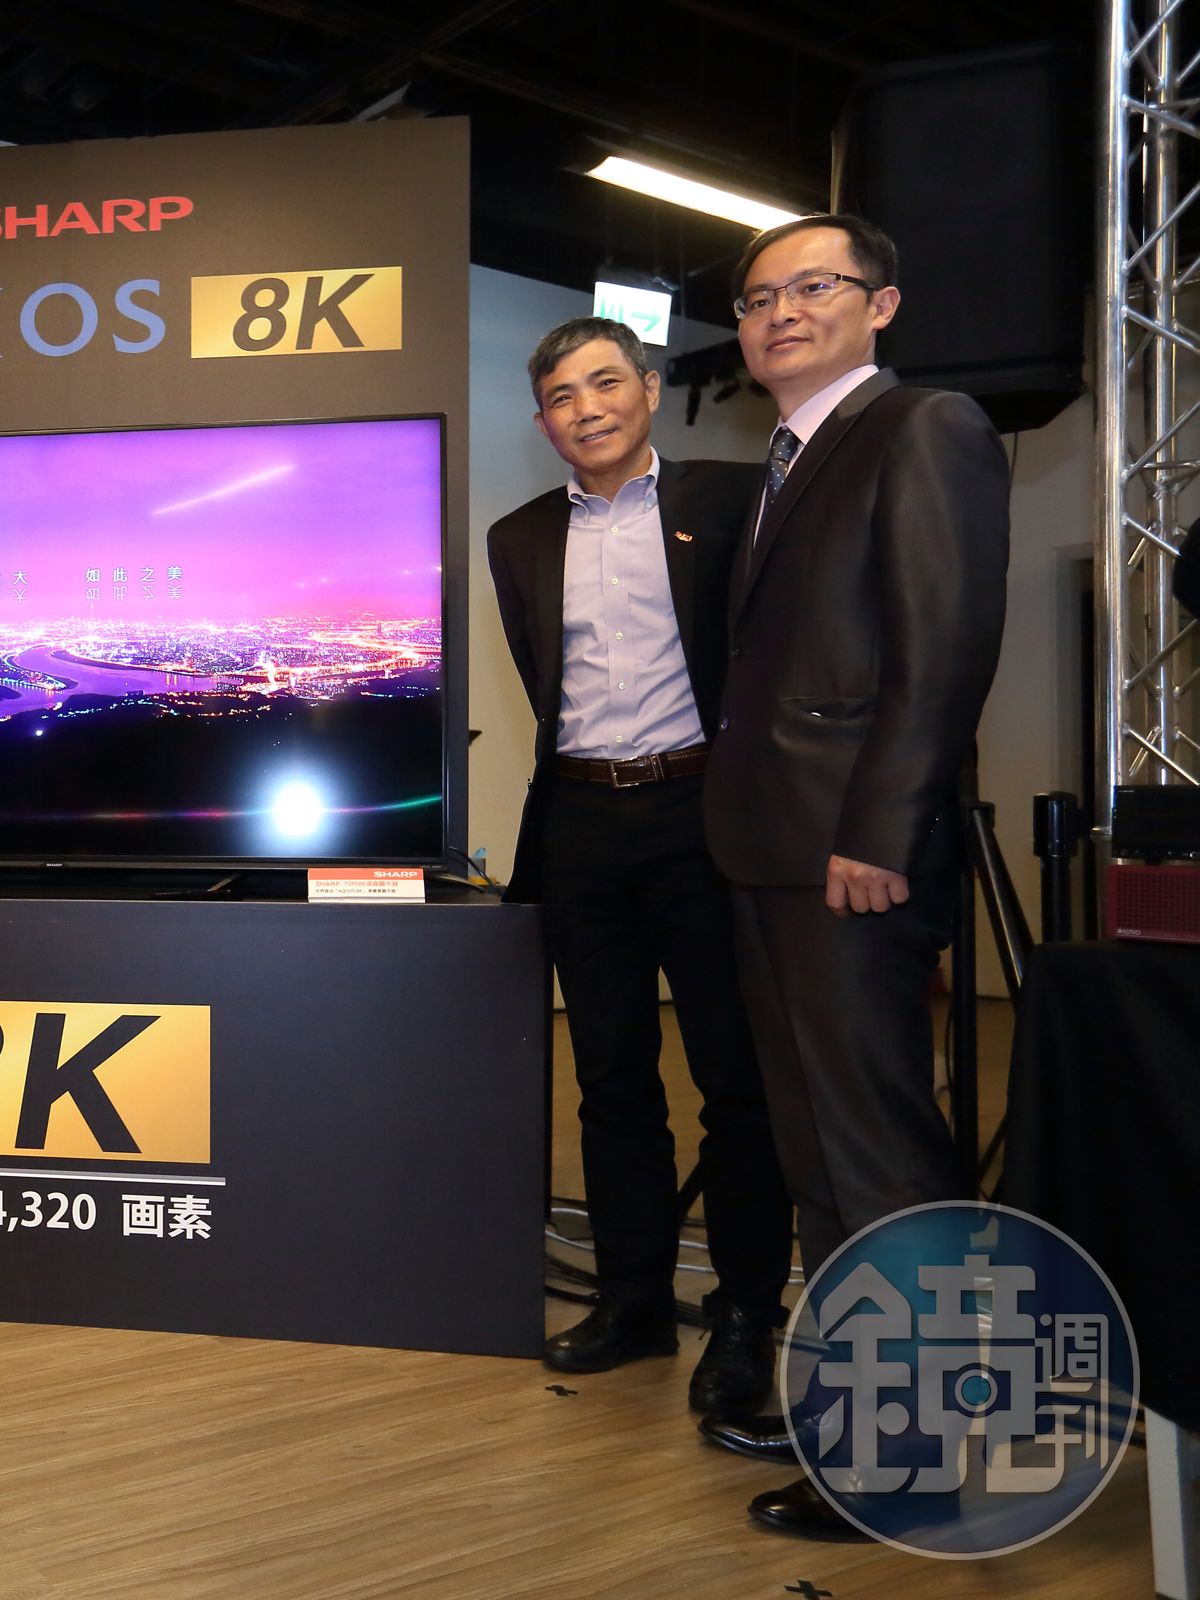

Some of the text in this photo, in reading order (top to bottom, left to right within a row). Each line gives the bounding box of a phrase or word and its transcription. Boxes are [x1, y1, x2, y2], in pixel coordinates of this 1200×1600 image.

[232, 273, 375, 352] 8K
[85, 565, 184, 583] 如此之美
[121, 1194, 212, 1240] 画素
